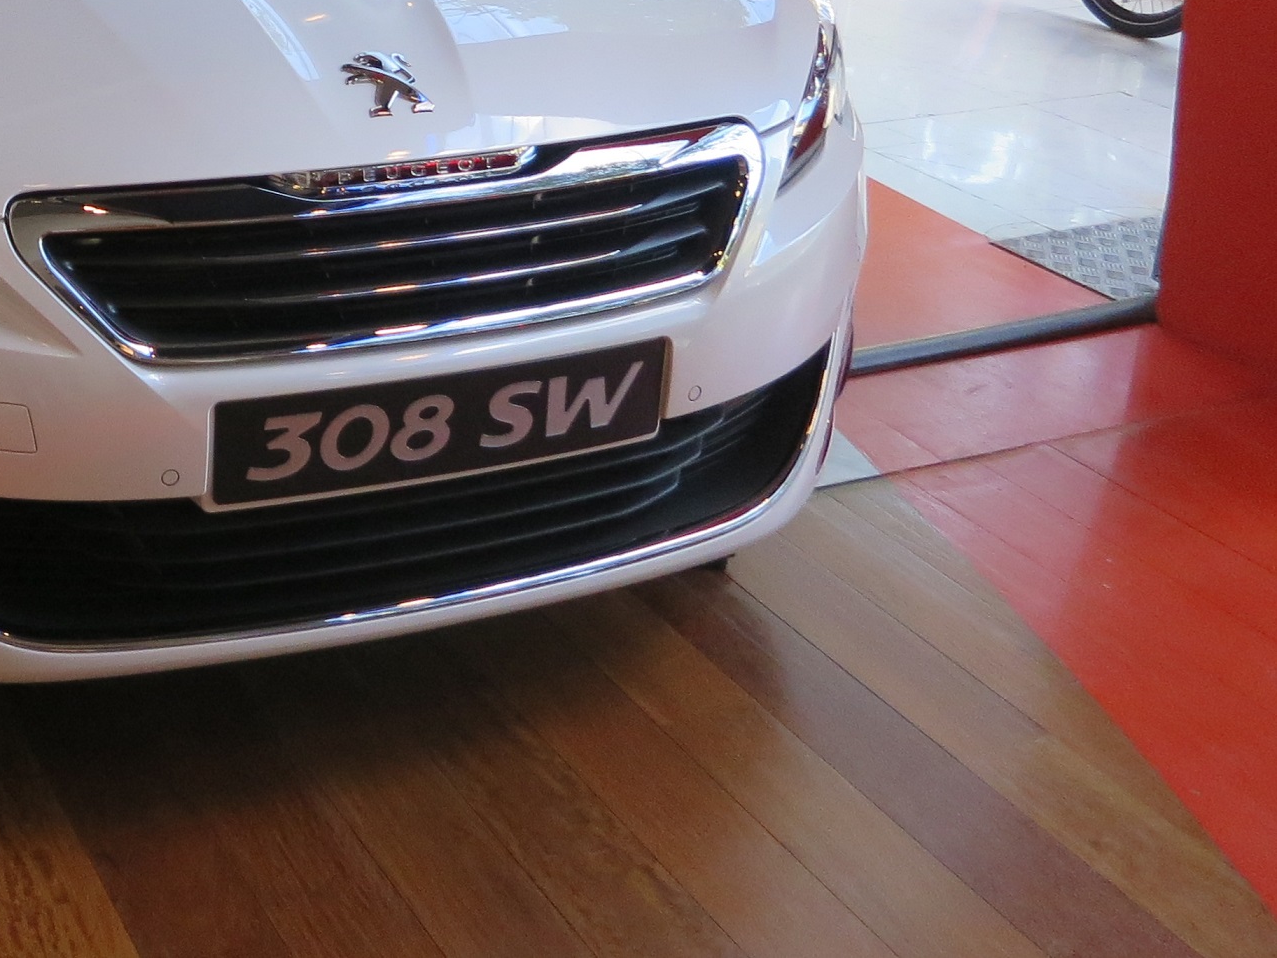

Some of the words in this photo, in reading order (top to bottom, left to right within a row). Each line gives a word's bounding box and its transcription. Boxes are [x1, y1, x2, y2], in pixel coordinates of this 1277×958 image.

[337, 156, 498, 185] PEUGEOT
[246, 394, 455, 482] 308
[479, 361, 644, 448] SW
